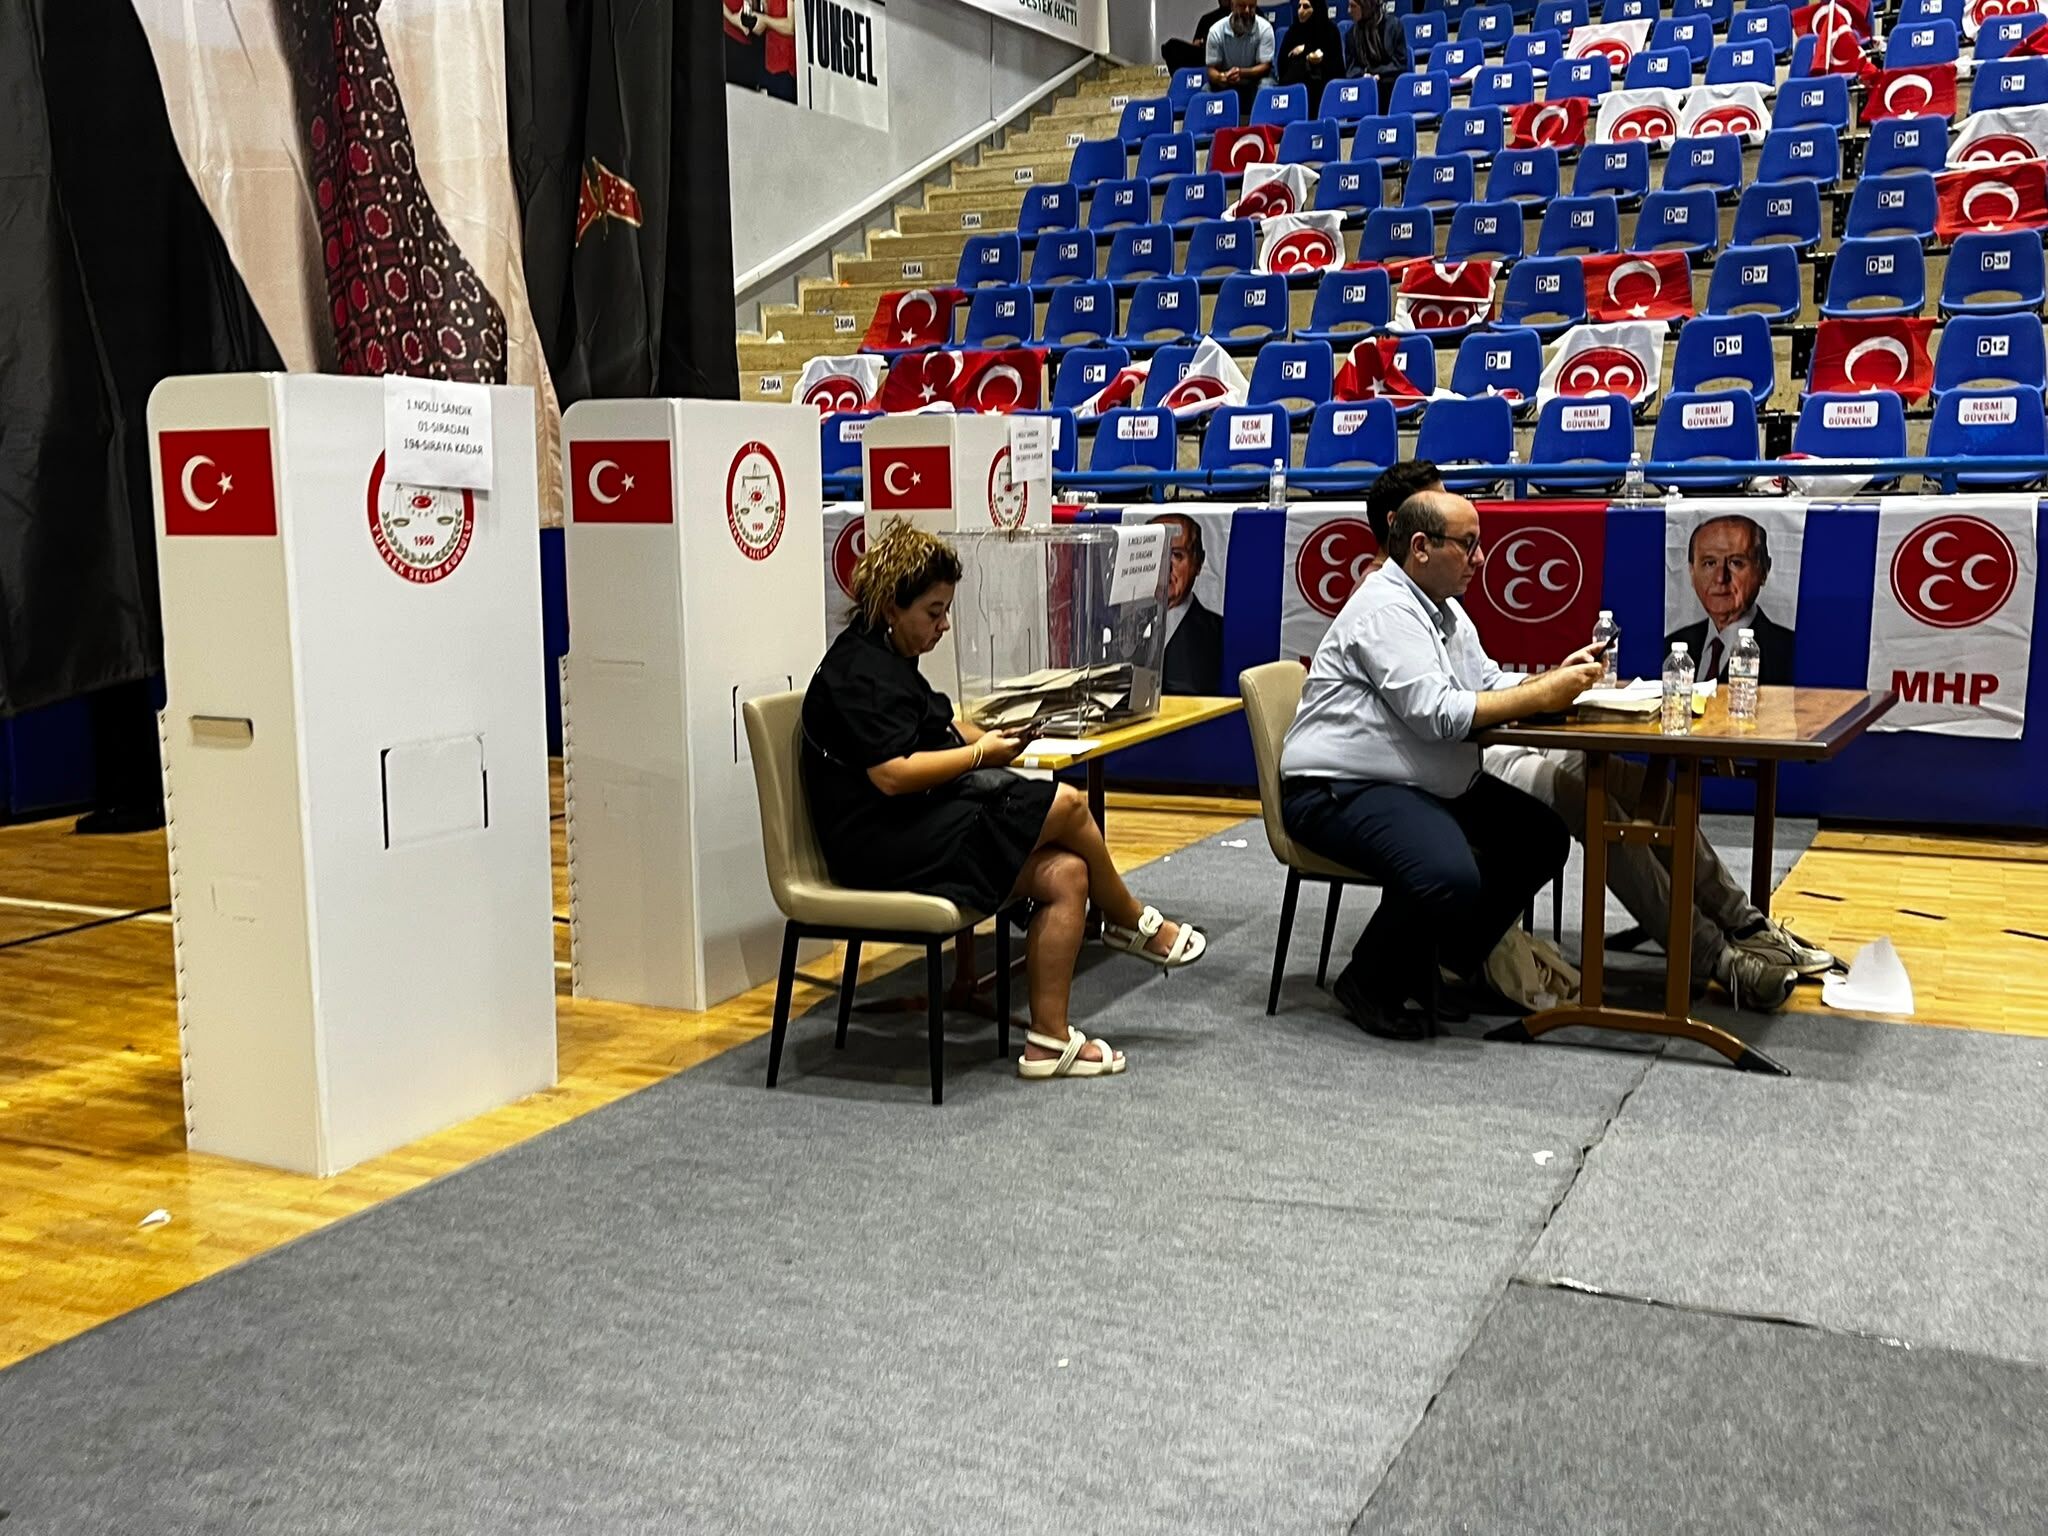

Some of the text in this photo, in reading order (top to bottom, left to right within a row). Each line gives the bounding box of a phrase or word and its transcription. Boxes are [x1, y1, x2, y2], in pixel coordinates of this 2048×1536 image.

[1344, 413, 1364, 422] RESM
[455, 443, 483, 455] KADAR
[1891, 669, 1999, 706] MHP
